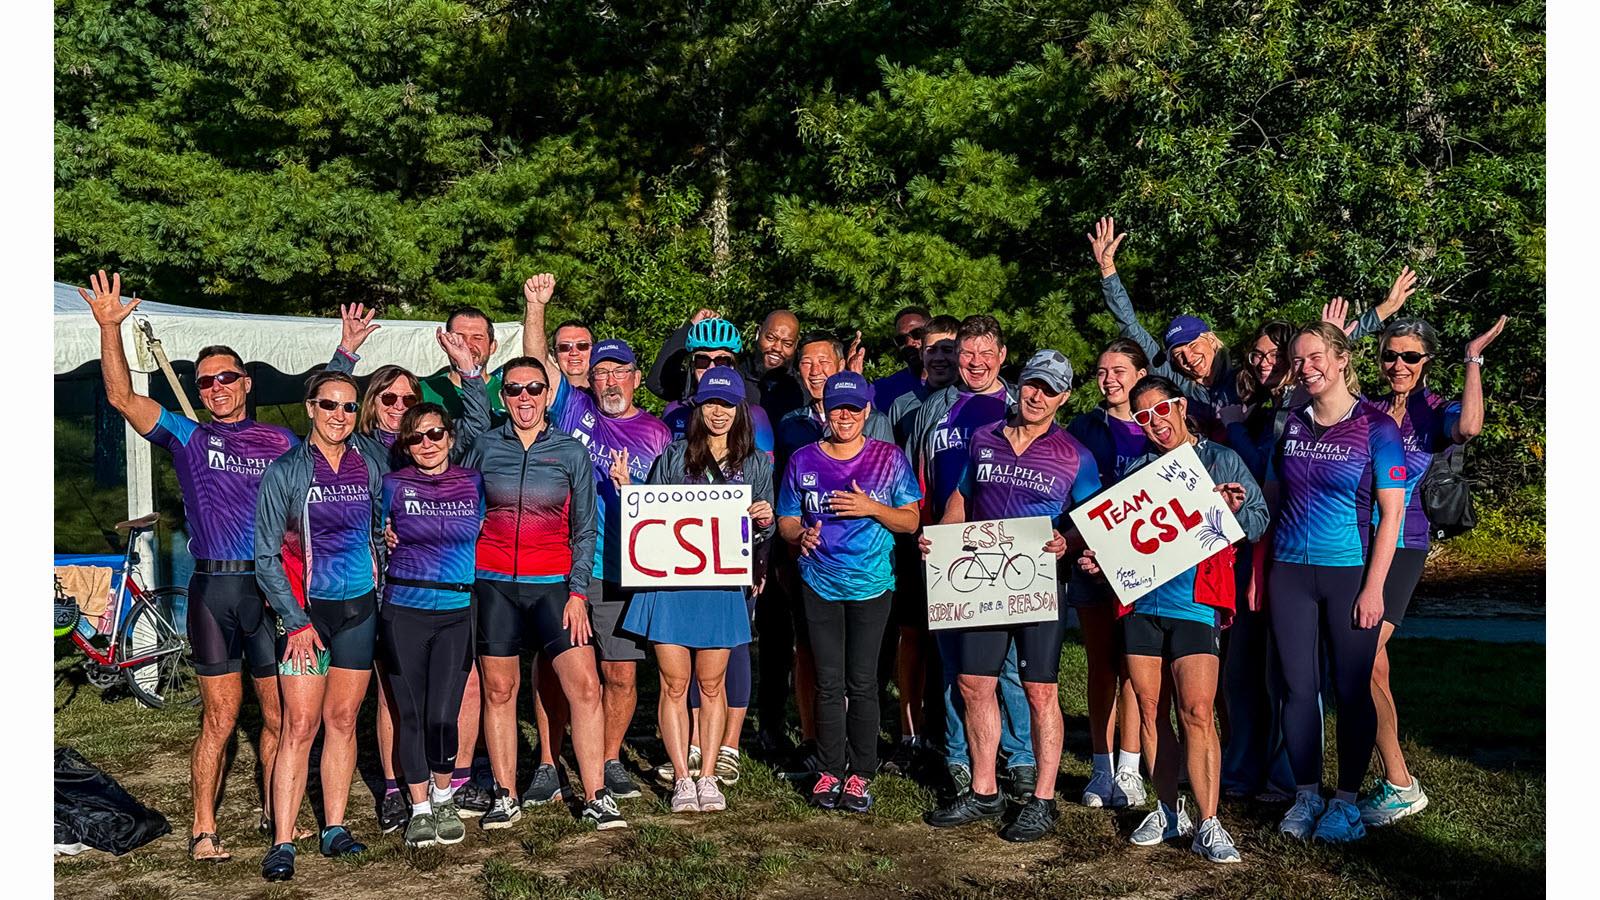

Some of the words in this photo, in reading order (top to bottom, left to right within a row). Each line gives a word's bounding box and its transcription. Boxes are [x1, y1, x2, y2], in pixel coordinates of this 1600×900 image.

[1292, 450, 1349, 462] FOUNDATION
[1295, 441, 1352, 455] ALPHA-1
[991, 465, 1056, 487] ALPHA-1
[1156, 459, 1182, 483] WAY
[990, 474, 1052, 494] FOUNDATION
[421, 500, 475, 510] ALPHA-1
[421, 509, 476, 517] FOUNDATION
[1087, 489, 1154, 531] TEAM
[962, 521, 1015, 549] CSL
[1130, 498, 1204, 555] CSL
[628, 516, 749, 577] CSL!
[928, 602, 975, 622] RIDING
[1008, 591, 1058, 616] REASON
